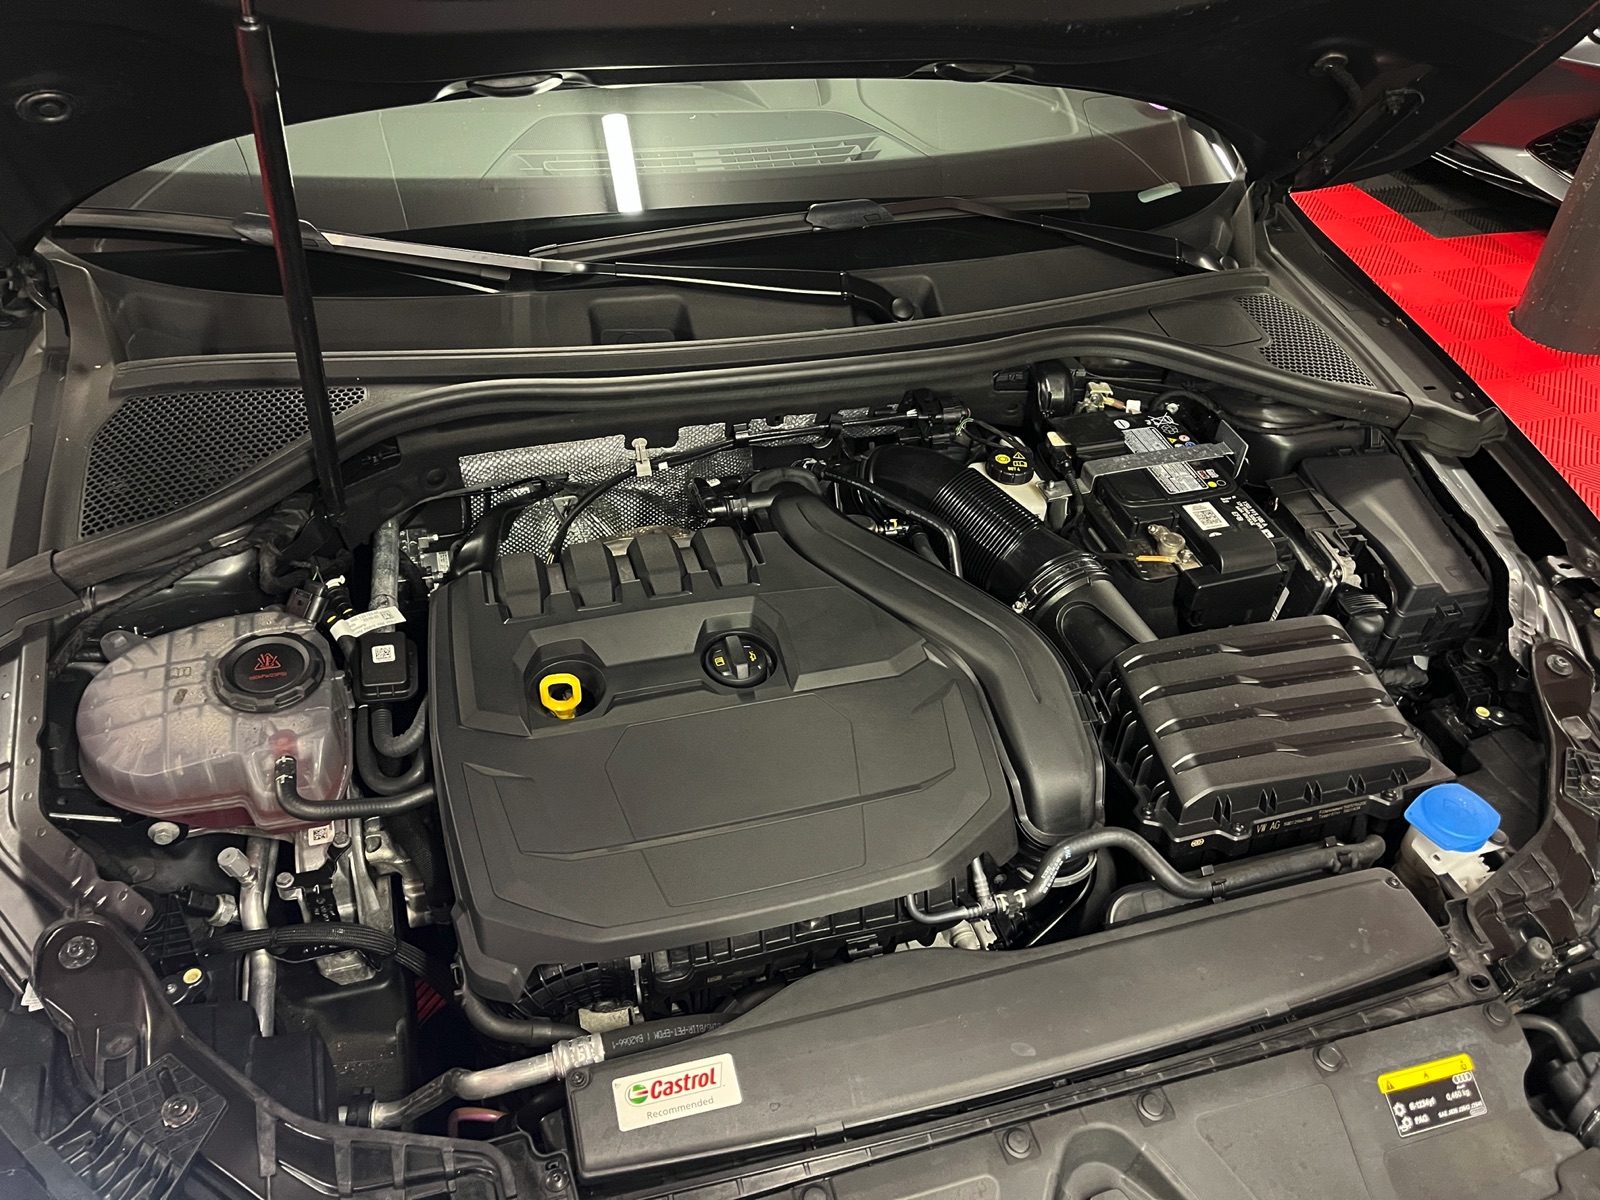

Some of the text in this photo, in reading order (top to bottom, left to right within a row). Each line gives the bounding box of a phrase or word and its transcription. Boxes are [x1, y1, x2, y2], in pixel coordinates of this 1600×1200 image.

[1256, 823, 1267, 833] VW
[1269, 820, 1281, 831] AG
[611, 1034, 644, 1050] BA2066-1
[650, 1067, 717, 1100] Castrol
[646, 1097, 714, 1120] Recommended
[1414, 1113, 1430, 1125] PAG
